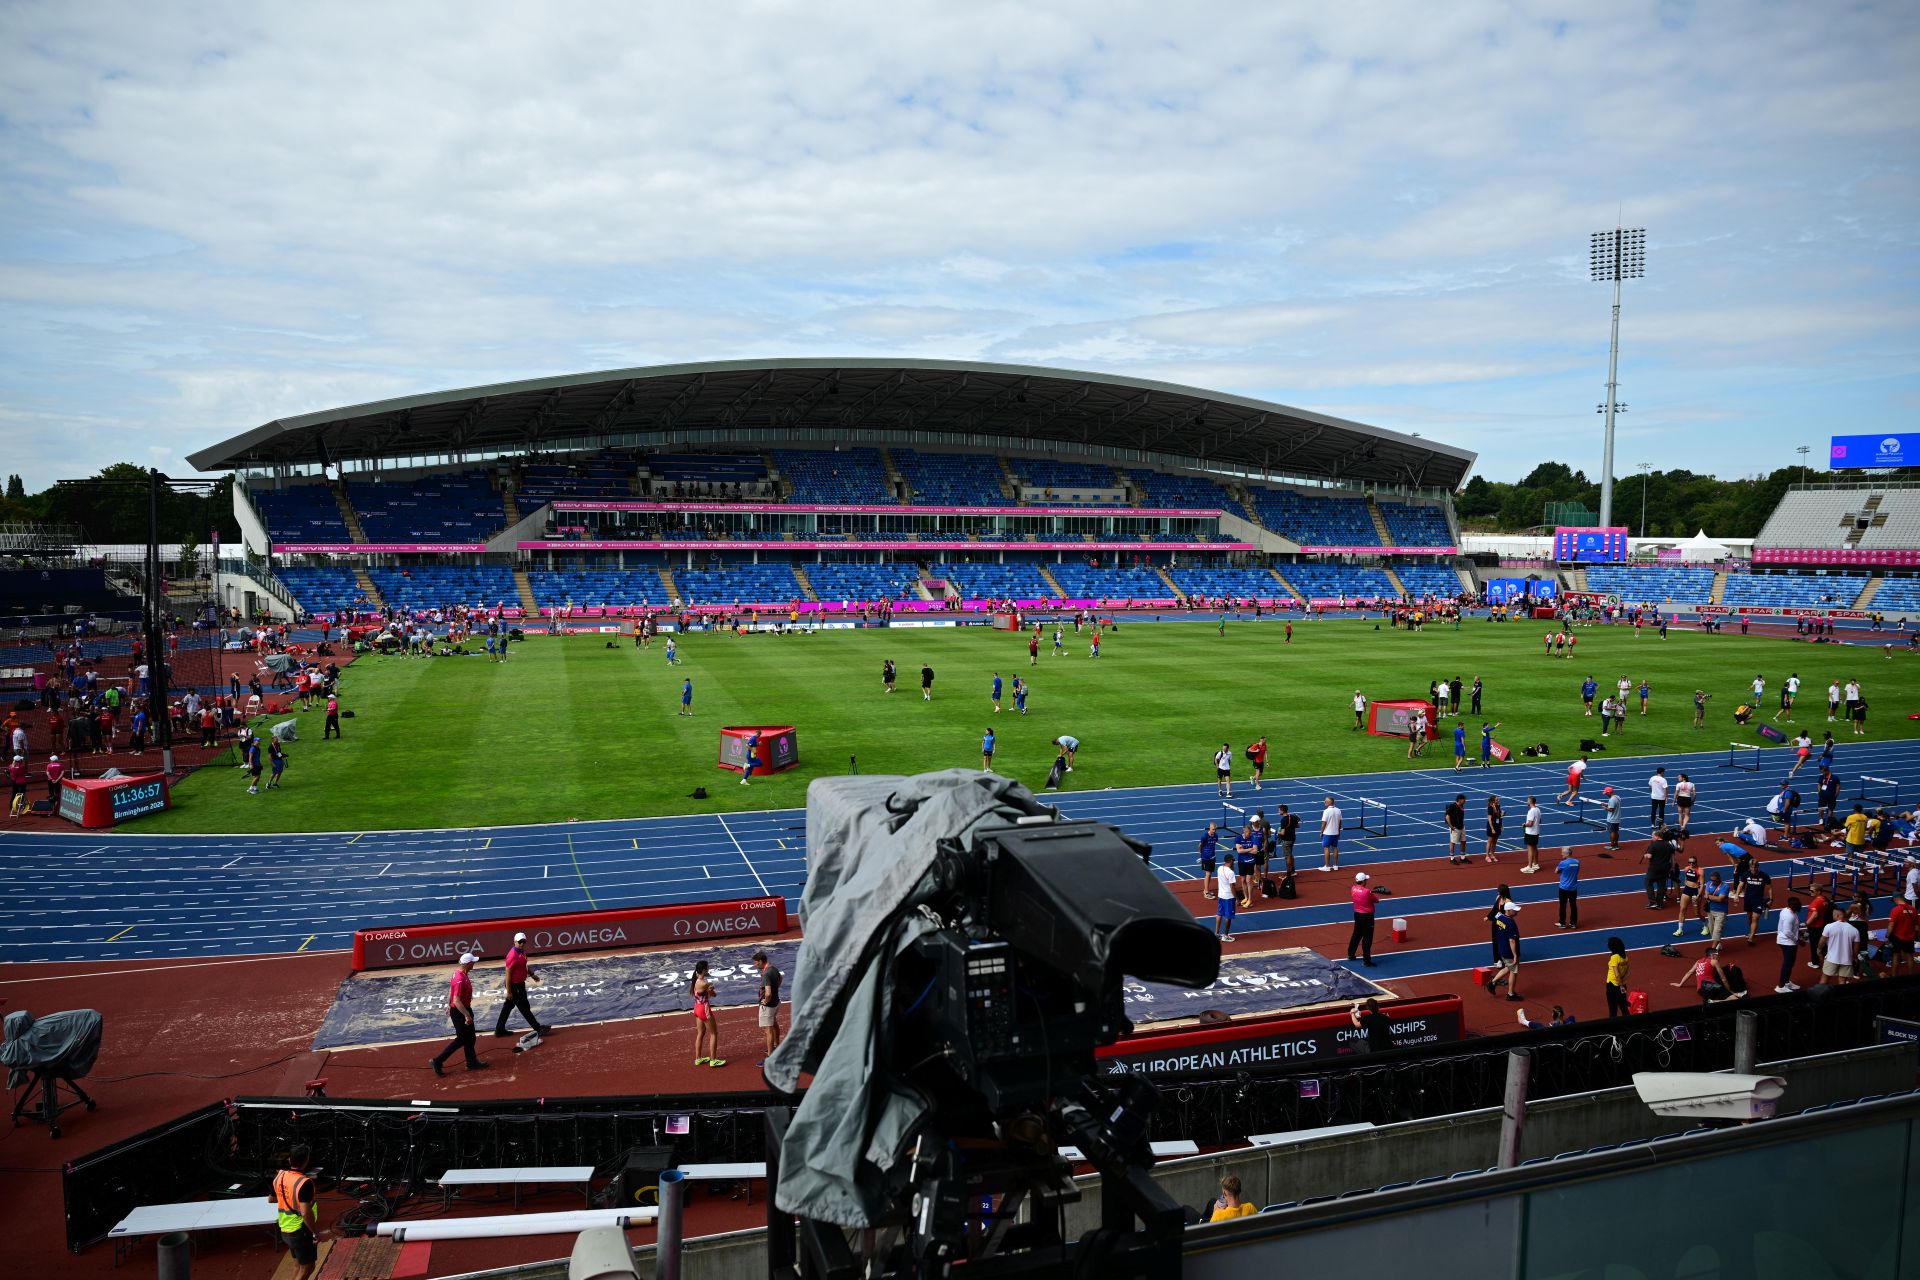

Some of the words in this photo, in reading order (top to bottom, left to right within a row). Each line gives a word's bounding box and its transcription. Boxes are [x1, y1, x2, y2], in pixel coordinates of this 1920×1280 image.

[113, 783, 161, 806] 11:36:57
[114, 805, 149, 819] Birmingham
[149, 800, 164, 810] 2026
[749, 901, 777, 910] OMEGA
[695, 916, 761, 934] OMEGA
[375, 931, 407, 942] OMEGA
[557, 927, 627, 946] OMEGA
[410, 938, 485, 960] OMEGA
[1336, 1020, 1427, 1042] CHAMNSHIPS
[1402, 1037, 1422, 1046] August
[1423, 1034, 1438, 1042] 2026
[1887, 1029, 1908, 1039] BLOCK
[1908, 1033, 1918, 1041] 122
[1132, 1051, 1225, 1073] EUROPEAN
[1228, 1039, 1317, 1065] ATHLETICS
